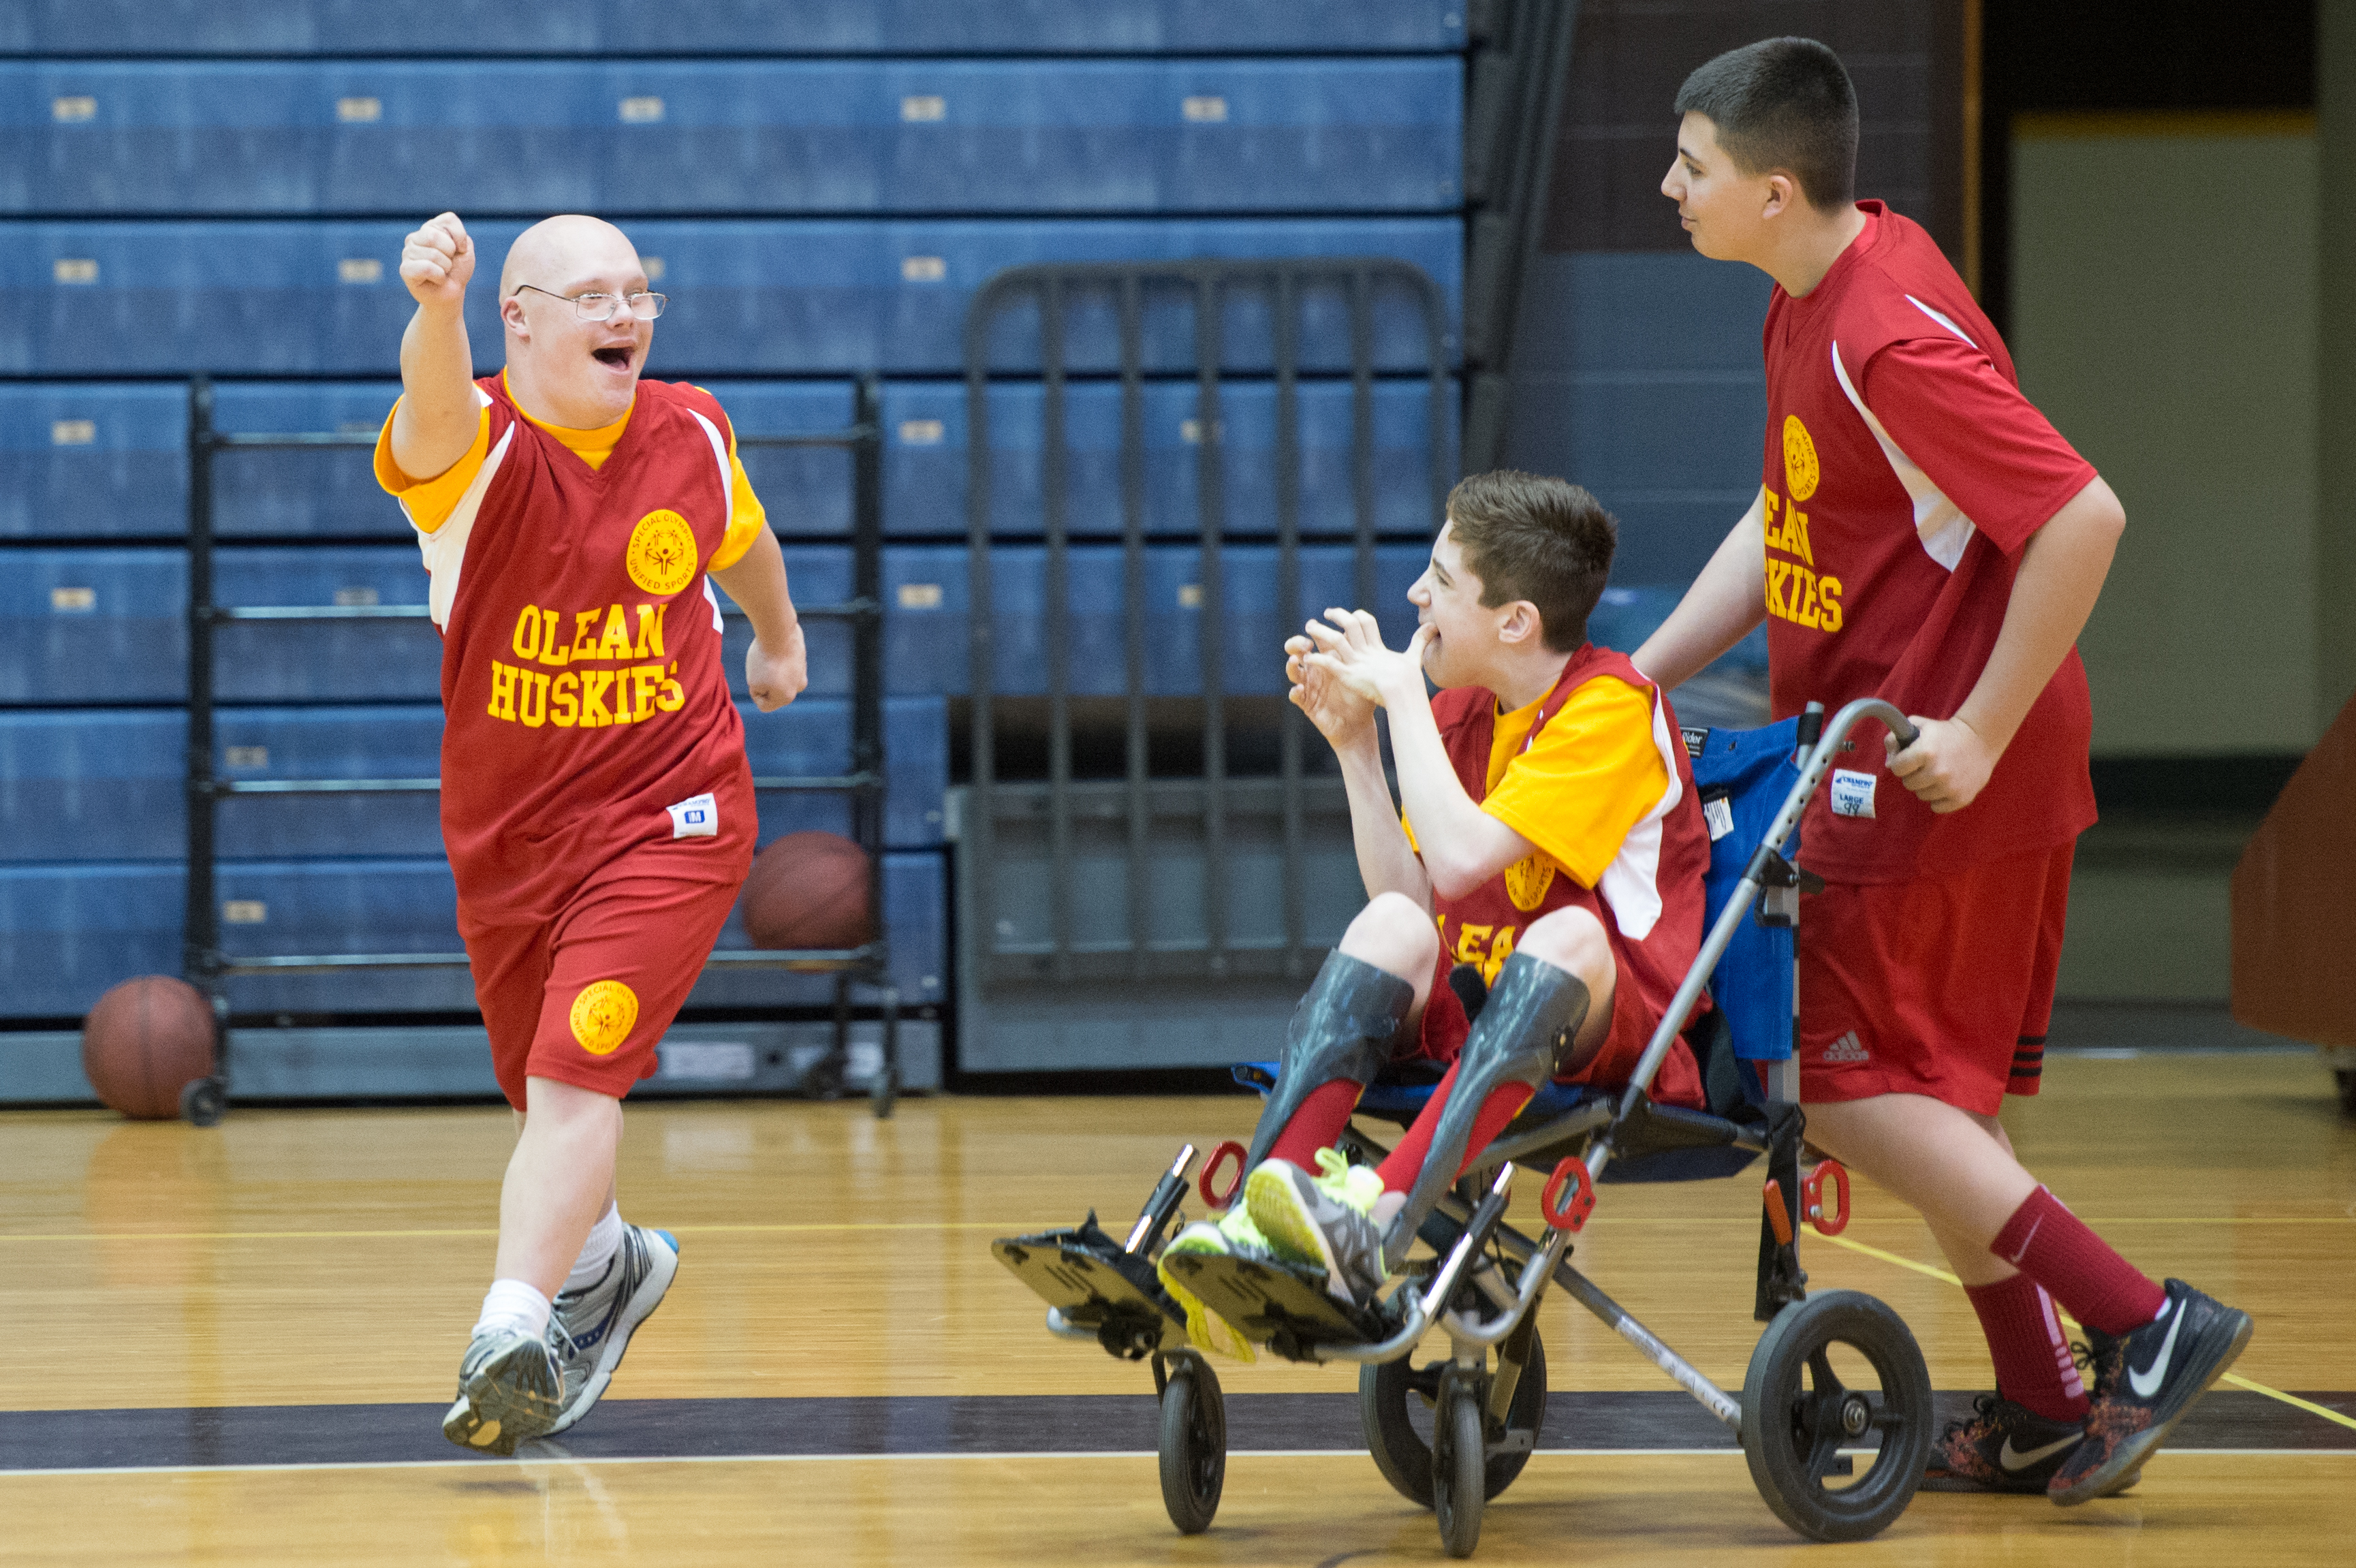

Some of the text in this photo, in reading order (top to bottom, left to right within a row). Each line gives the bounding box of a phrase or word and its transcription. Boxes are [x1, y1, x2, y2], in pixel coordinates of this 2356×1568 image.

[1795, 473, 1816, 497] SPORTS
[633, 514, 694, 550] SPECIAL OLYMPICS
[630, 559, 694, 591] UNIFIED SPORTS
[1765, 557, 1844, 633] KIES
[512, 603, 668, 666] OLEAN
[487, 659, 685, 728] HUSKIES
[1840, 794, 1864, 804] LARGE
[580, 985, 614, 1005] SPECIAL
[574, 1013, 594, 1046] UNIFIED
